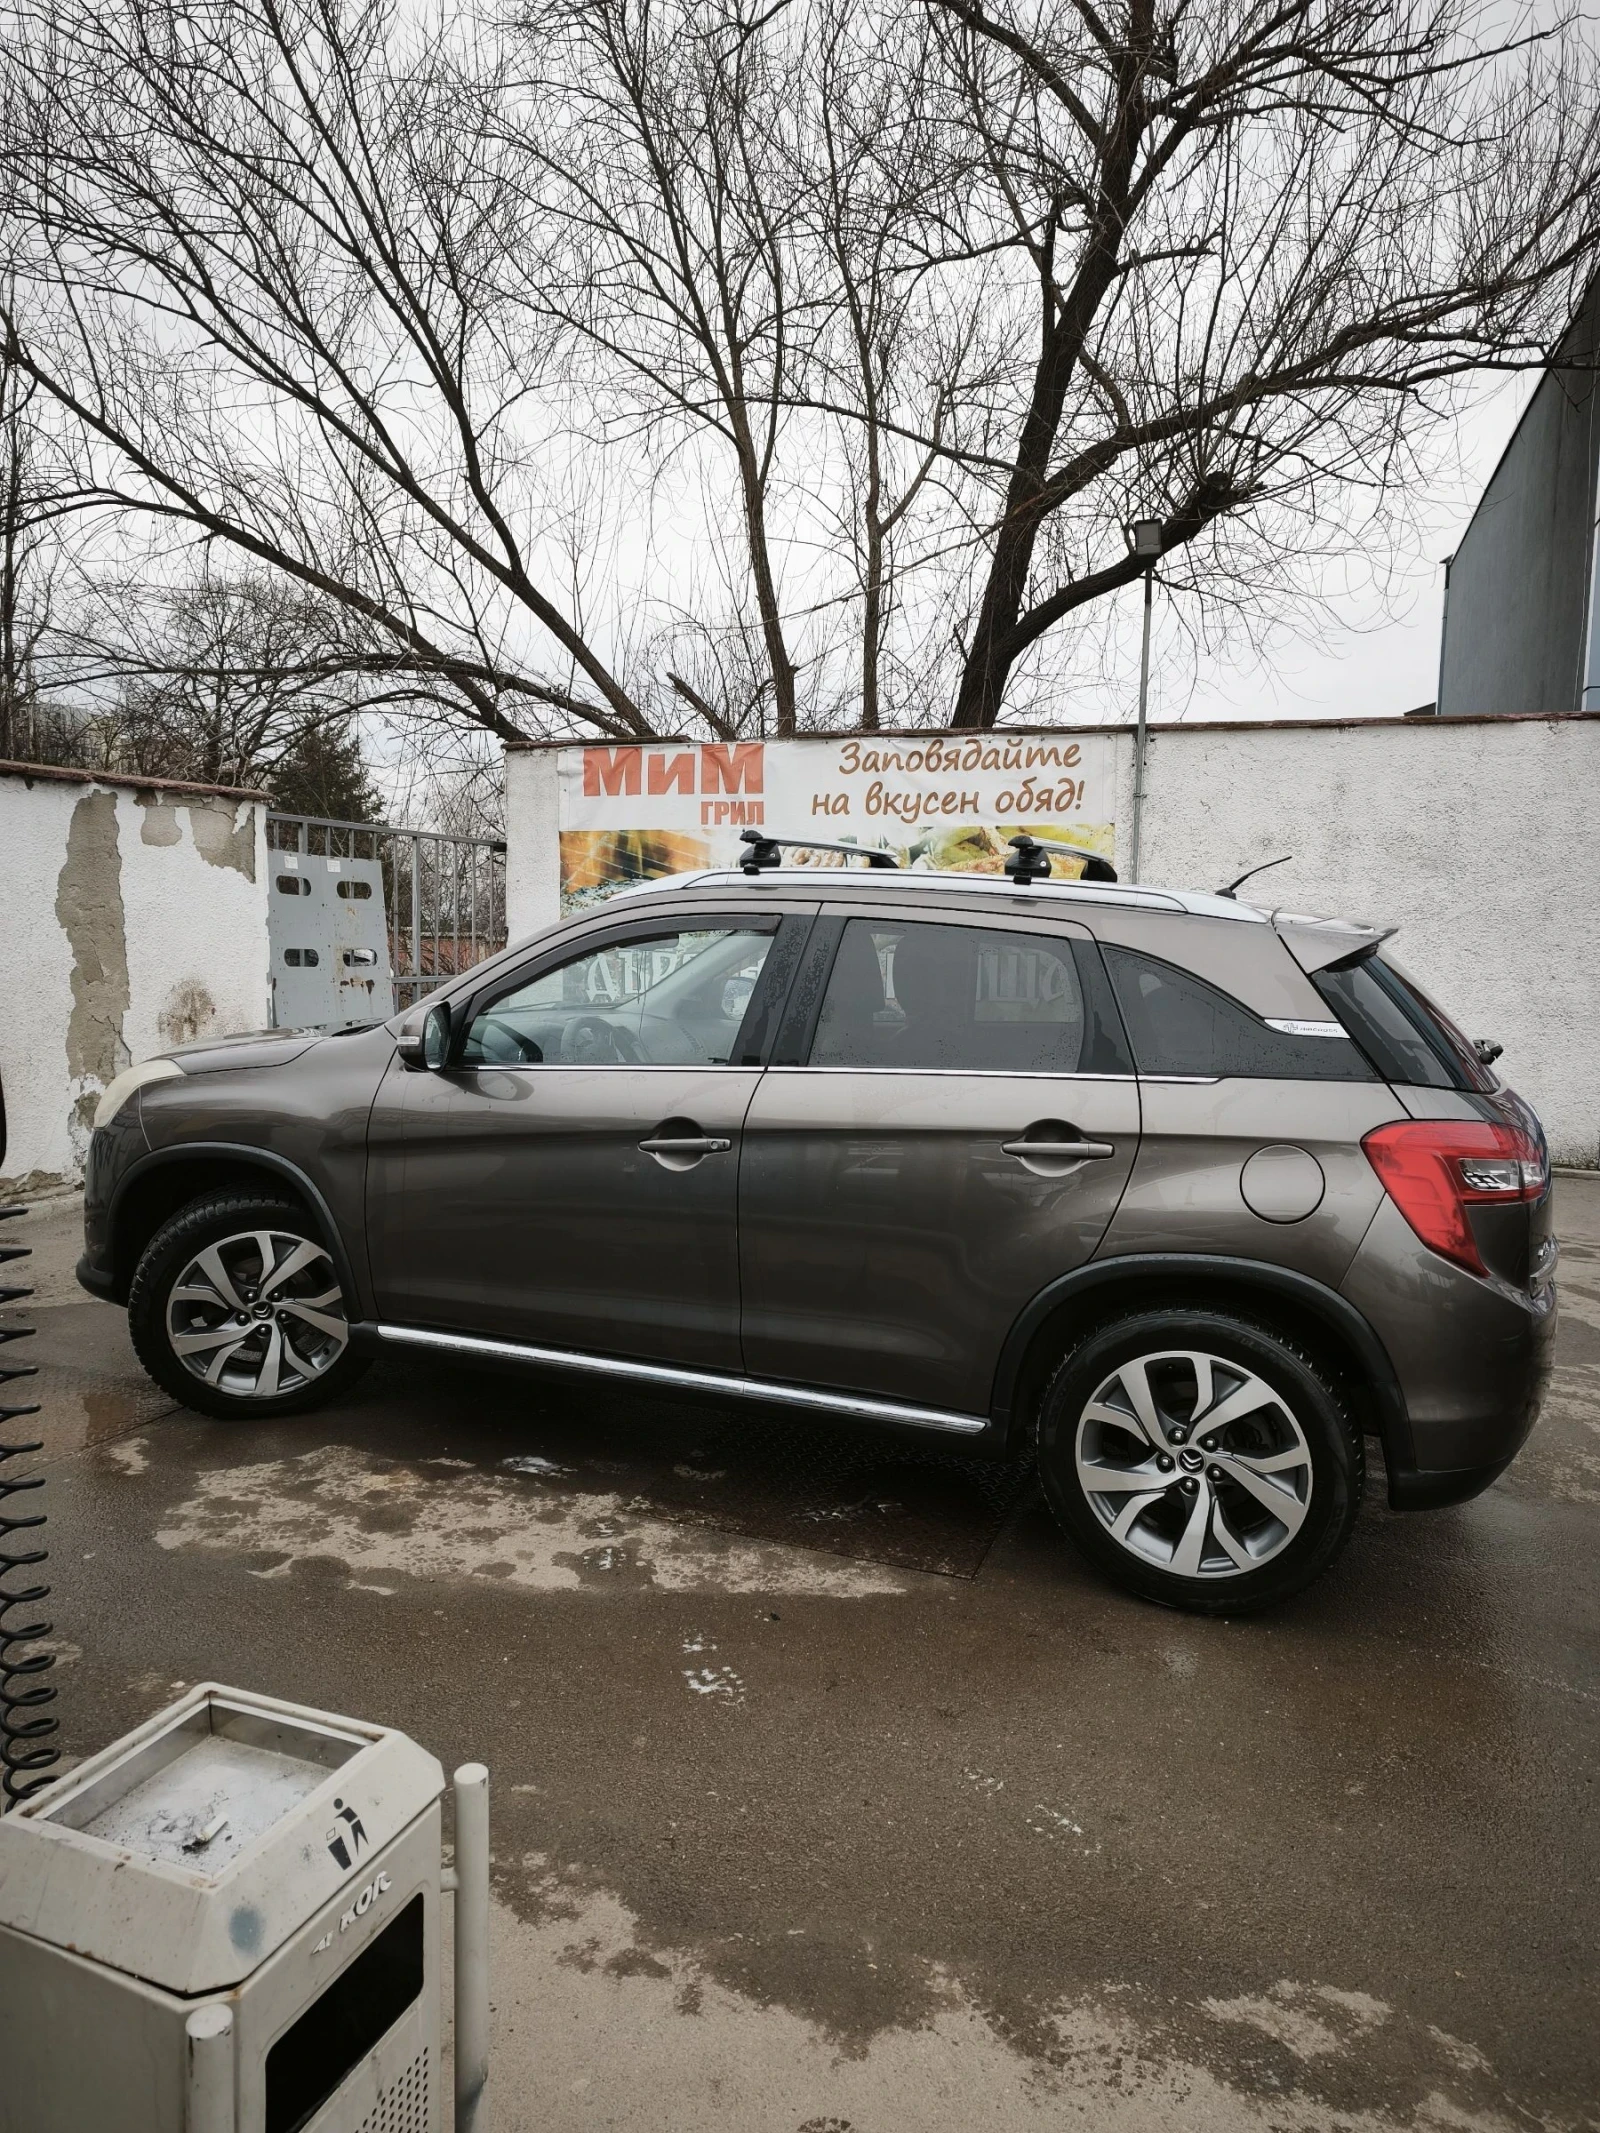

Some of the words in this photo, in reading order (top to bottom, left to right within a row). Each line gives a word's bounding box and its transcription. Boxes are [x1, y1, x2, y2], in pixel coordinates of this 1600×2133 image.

[839, 738, 1082, 775] Заповядайте
[701, 800, 765, 826] ГРИЛ
[811, 793, 850, 816] на
[865, 781, 979, 824] вкусен
[995, 776, 1086, 814] обяд!
